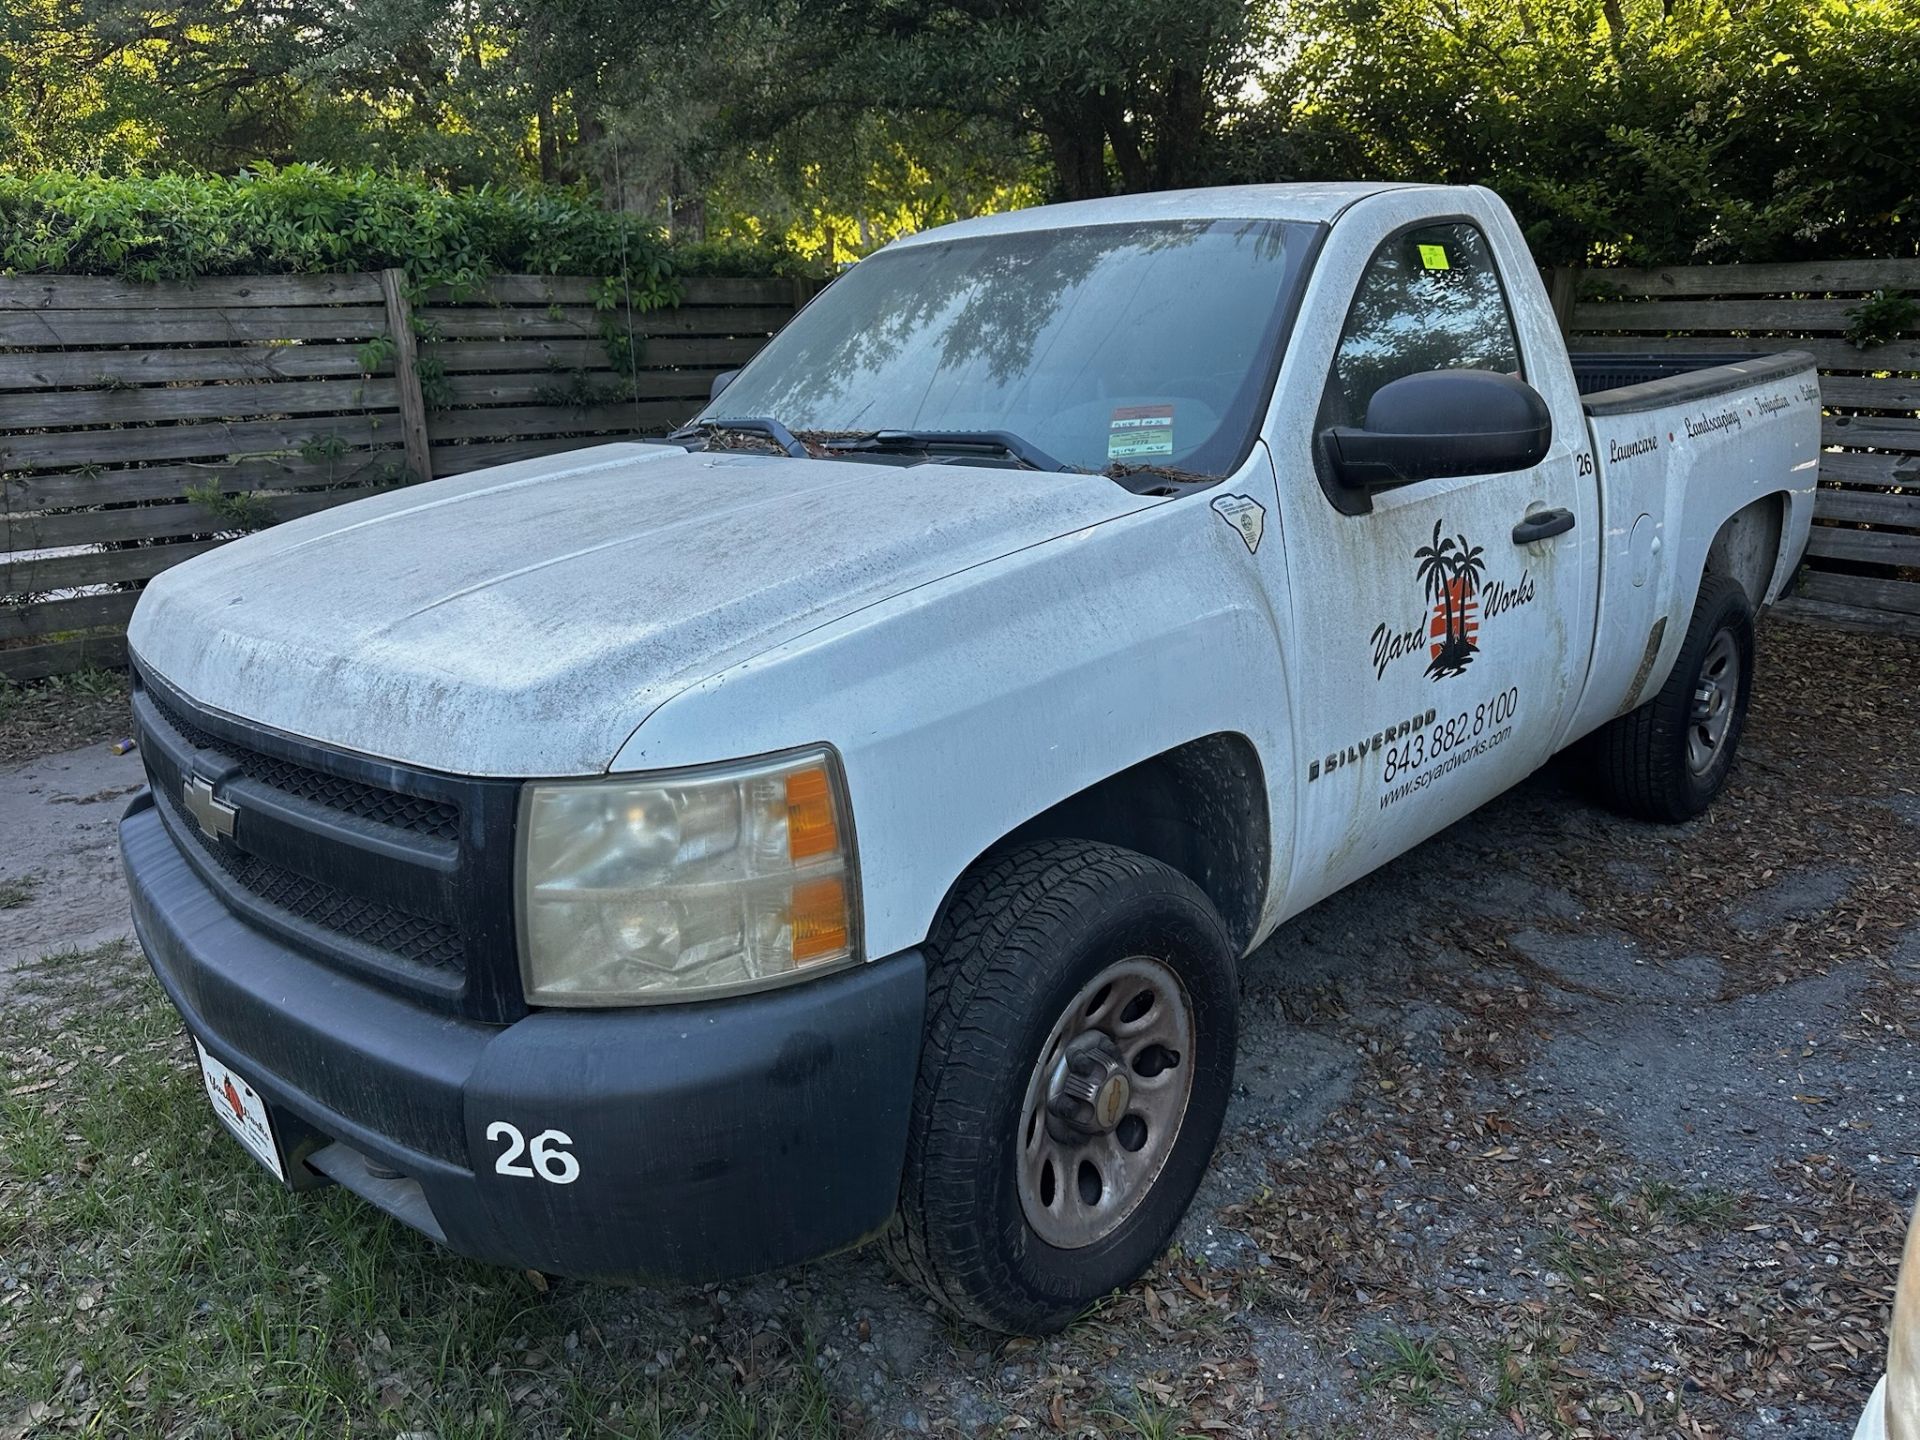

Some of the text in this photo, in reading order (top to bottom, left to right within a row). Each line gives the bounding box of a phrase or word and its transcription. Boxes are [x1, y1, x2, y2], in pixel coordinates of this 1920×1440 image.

[1576, 453, 1592, 477] 26
[1610, 436, 1658, 464] Lawncare
[1684, 410, 1741, 438] Landscaping
[1370, 568, 1536, 682] Yard Works
[1324, 708, 1437, 775] SILVERADO
[1379, 726, 1513, 811] www.scyardworks.com
[1384, 687, 1518, 784] 843.882.8100
[486, 1121, 580, 1184] 26
